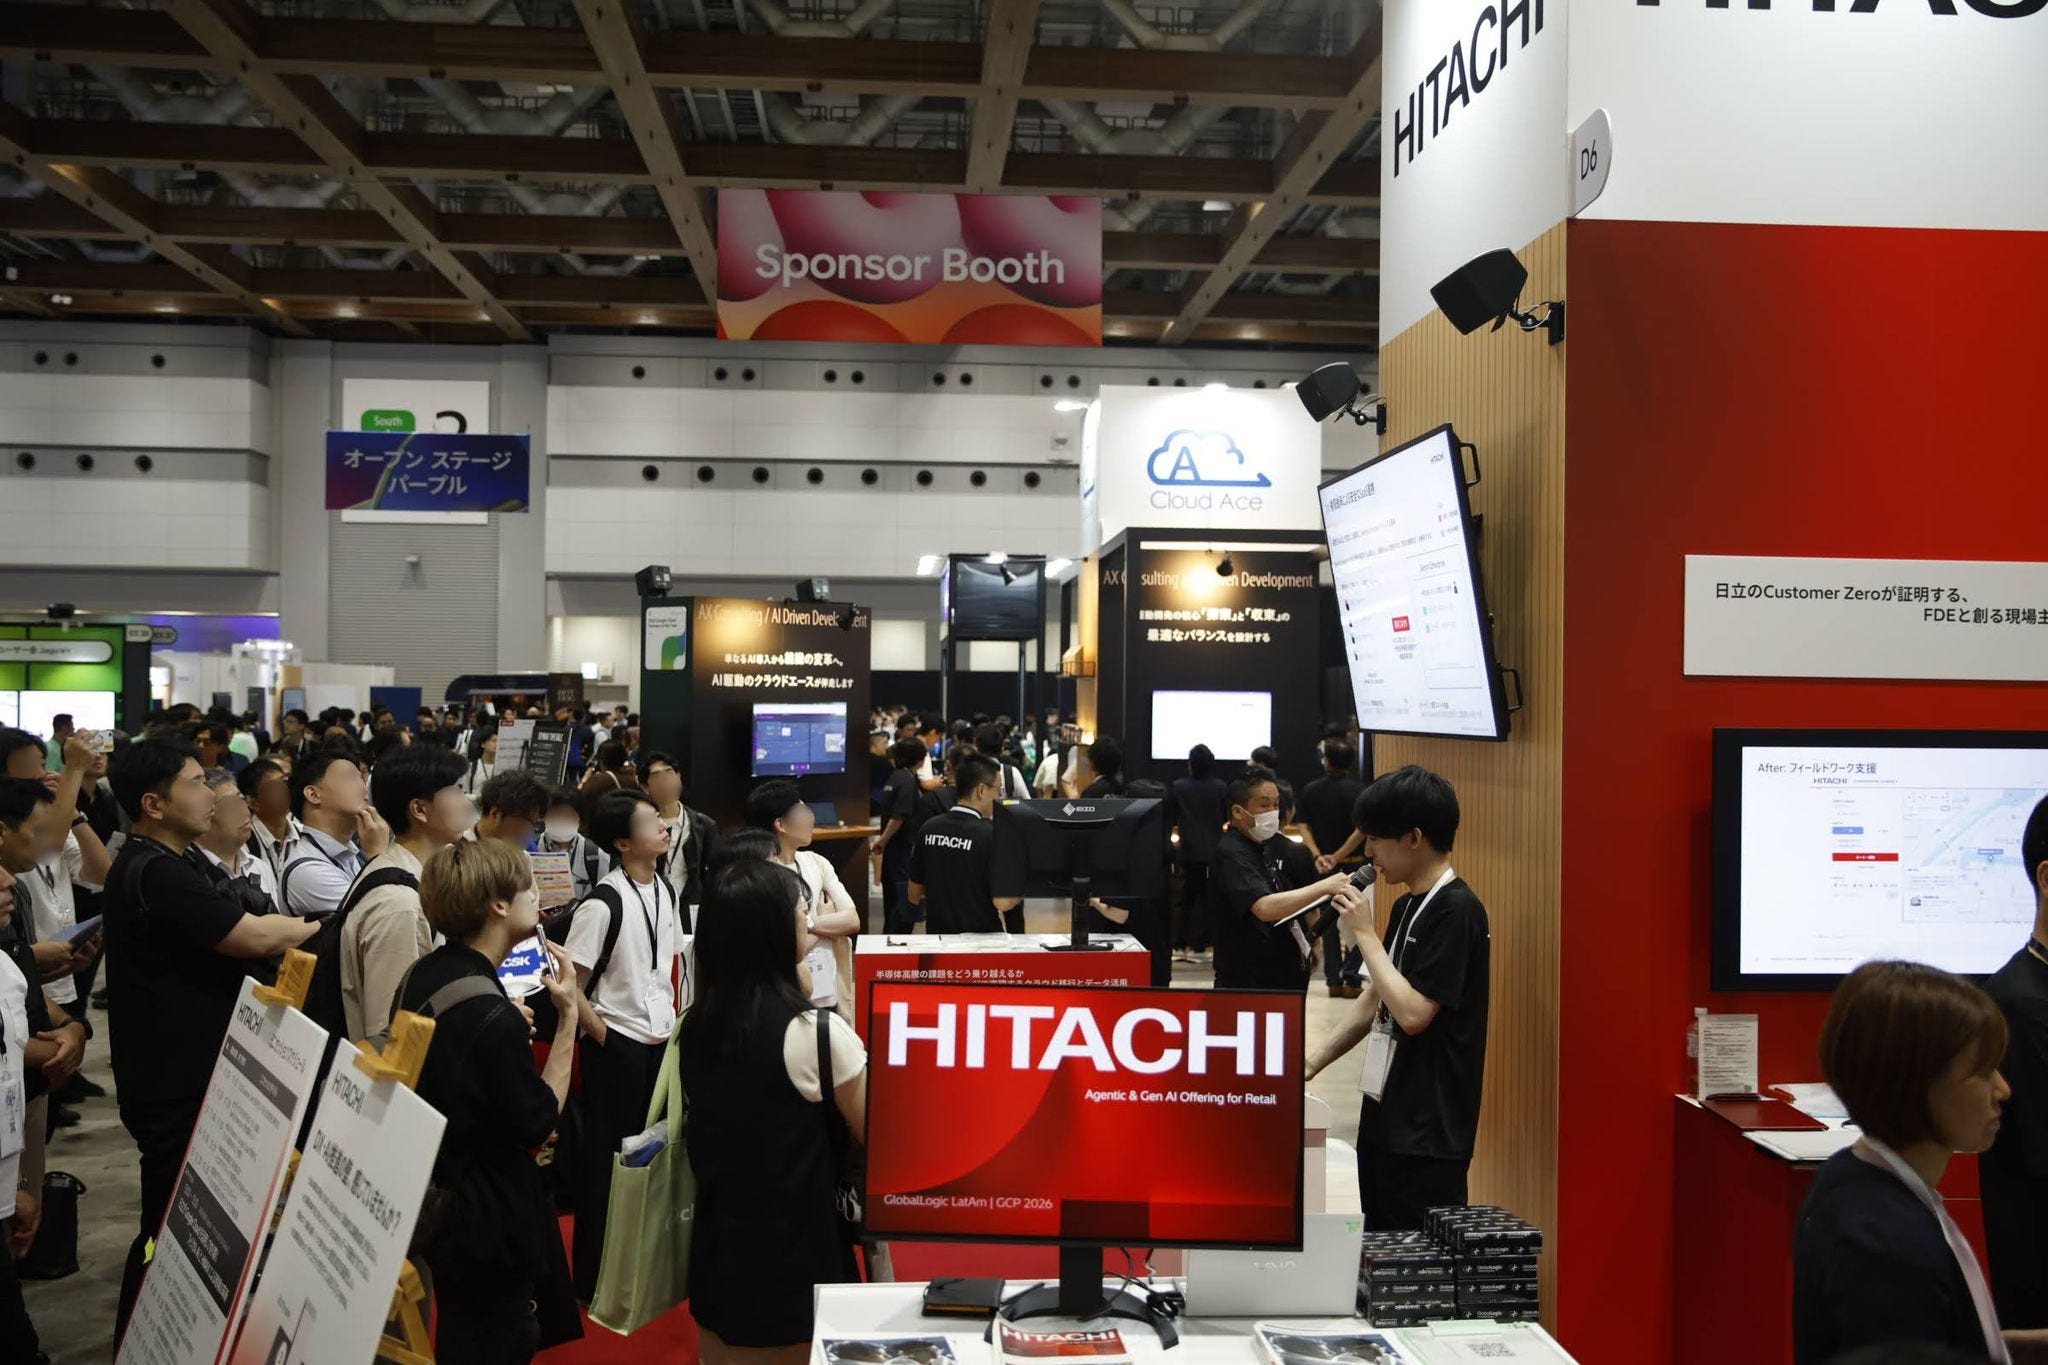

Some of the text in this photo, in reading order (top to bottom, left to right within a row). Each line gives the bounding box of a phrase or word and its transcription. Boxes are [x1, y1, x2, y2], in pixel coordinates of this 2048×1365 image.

[1581, 140, 1597, 180] D6
[755, 244, 1065, 288] Sponsor Booth
[373, 416, 403, 428] South
[344, 449, 512, 471] オープン ステージ
[387, 474, 468, 495] パープル
[1150, 490, 1263, 511] Cloud Ace
[1103, 569, 1119, 585] AX
[1141, 571, 1179, 590] sulting
[1241, 571, 1313, 590] Development
[1715, 582, 1969, 603] 日立のCustomer Zeroが証明する、
[699, 603, 712, 620] AX
[714, 604, 763, 627] Cting
[772, 607, 781, 624] AI
[783, 608, 810, 626] Driven
[813, 609, 867, 629] Develent
[1923, 608, 2048, 625] FDEと創る現場主
[1147, 628, 1271, 644] 最適なバランスを設計する
[711, 673, 854, 689] AI駆動のクラウドエースが伴走します
[1758, 762, 1877, 775] After: フィールドワーク支援
[1813, 777, 1848, 785] HITACHI
[925, 834, 973, 851] HITACHI
[501, 955, 530, 968] CSK
[237, 1002, 264, 1036] HITACHI
[888, 1002, 1285, 1076] HITACHI
[332, 1070, 366, 1114] HITACHI
[1085, 1089, 1277, 1105] Agentic & Gen AI Offering for Retail
[884, 1194, 948, 1209] GlobalLogic
[951, 1196, 987, 1208] LatAm
[996, 1197, 1021, 1208] GCP
[1024, 1198, 1054, 1209] 2026
[1001, 1325, 1116, 1342] HITACHI
